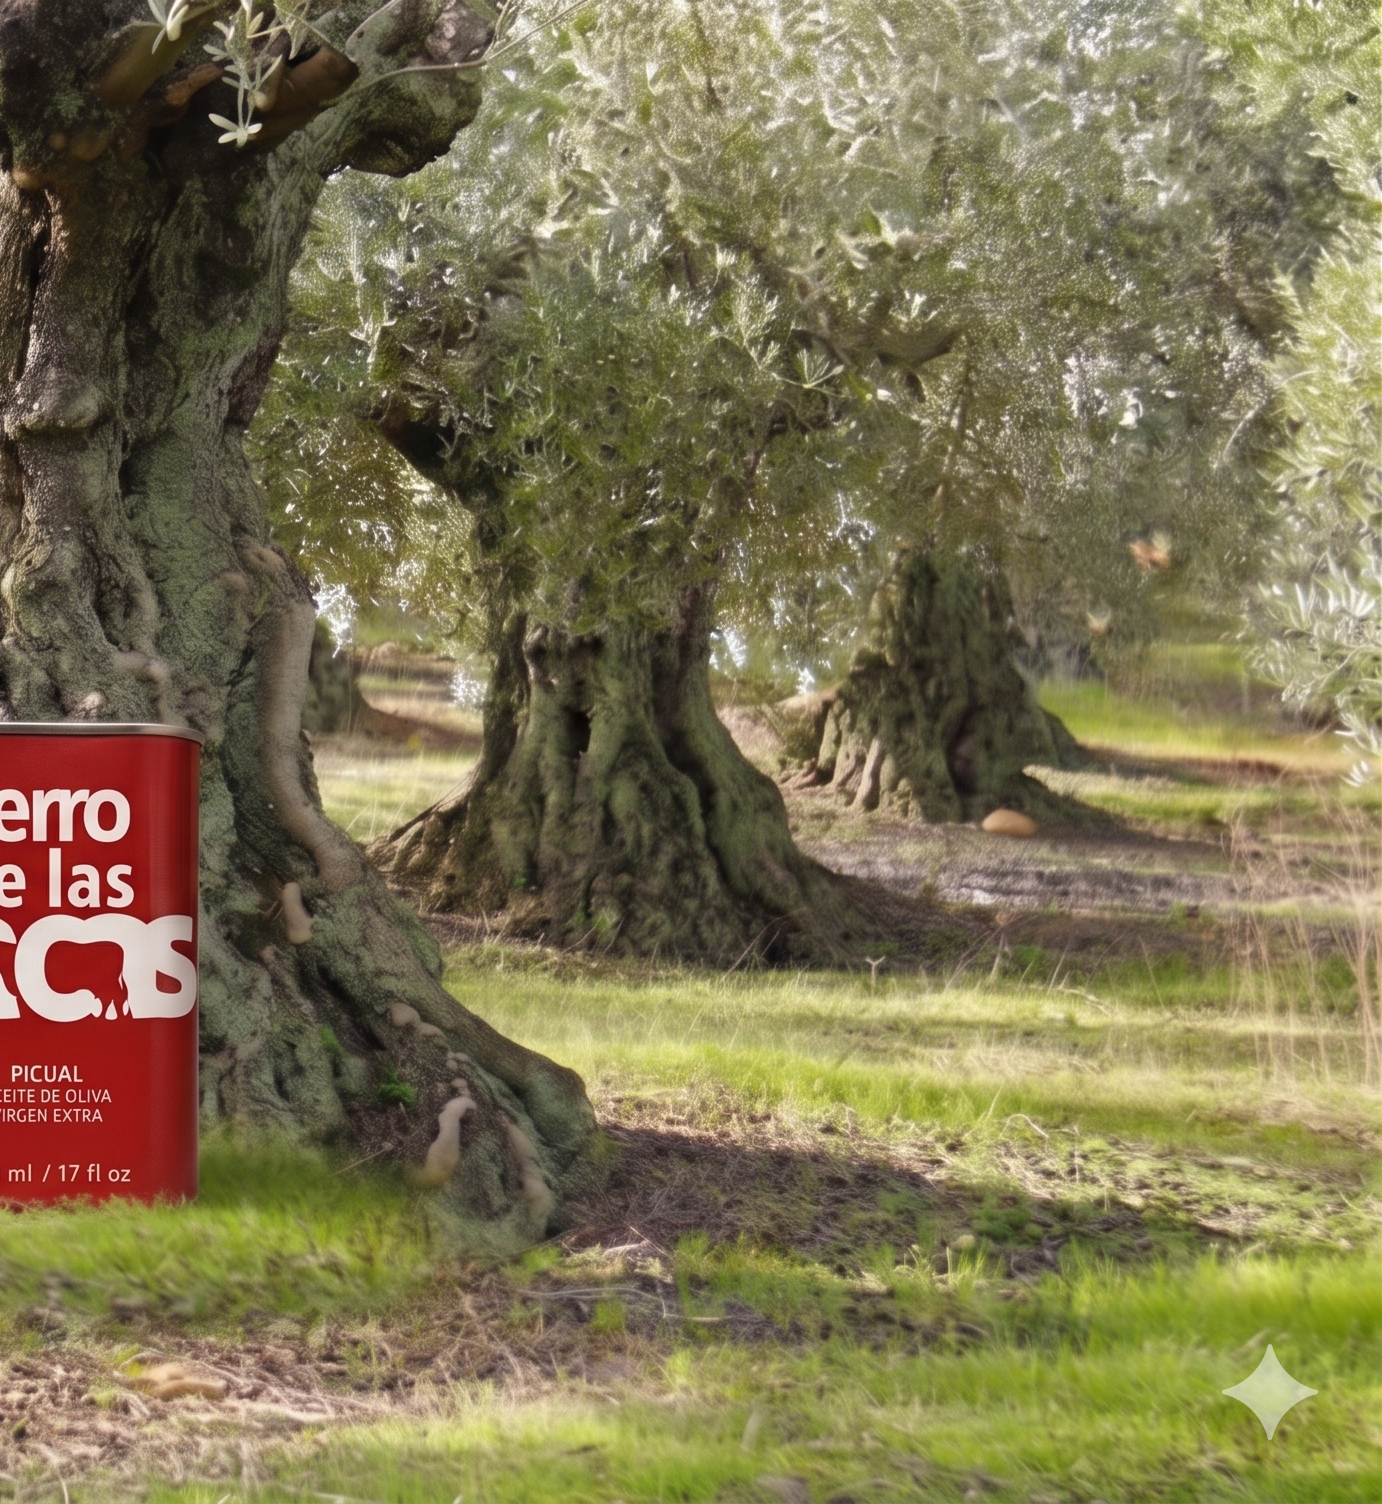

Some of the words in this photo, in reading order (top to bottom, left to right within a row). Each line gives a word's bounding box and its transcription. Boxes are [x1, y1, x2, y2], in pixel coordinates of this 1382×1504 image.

[48, 847, 135, 909] las
[11, 1065, 84, 1083] PICUAL
[40, 1089, 61, 1103] DE
[65, 1089, 112, 1103] OLIVA
[53, 1108, 103, 1123] EXTRA
[8, 1164, 32, 1182] ml
[42, 1164, 51, 1183] /
[58, 1164, 80, 1182] 17
[86, 1164, 101, 1182] fl
[108, 1168, 131, 1182] oz
